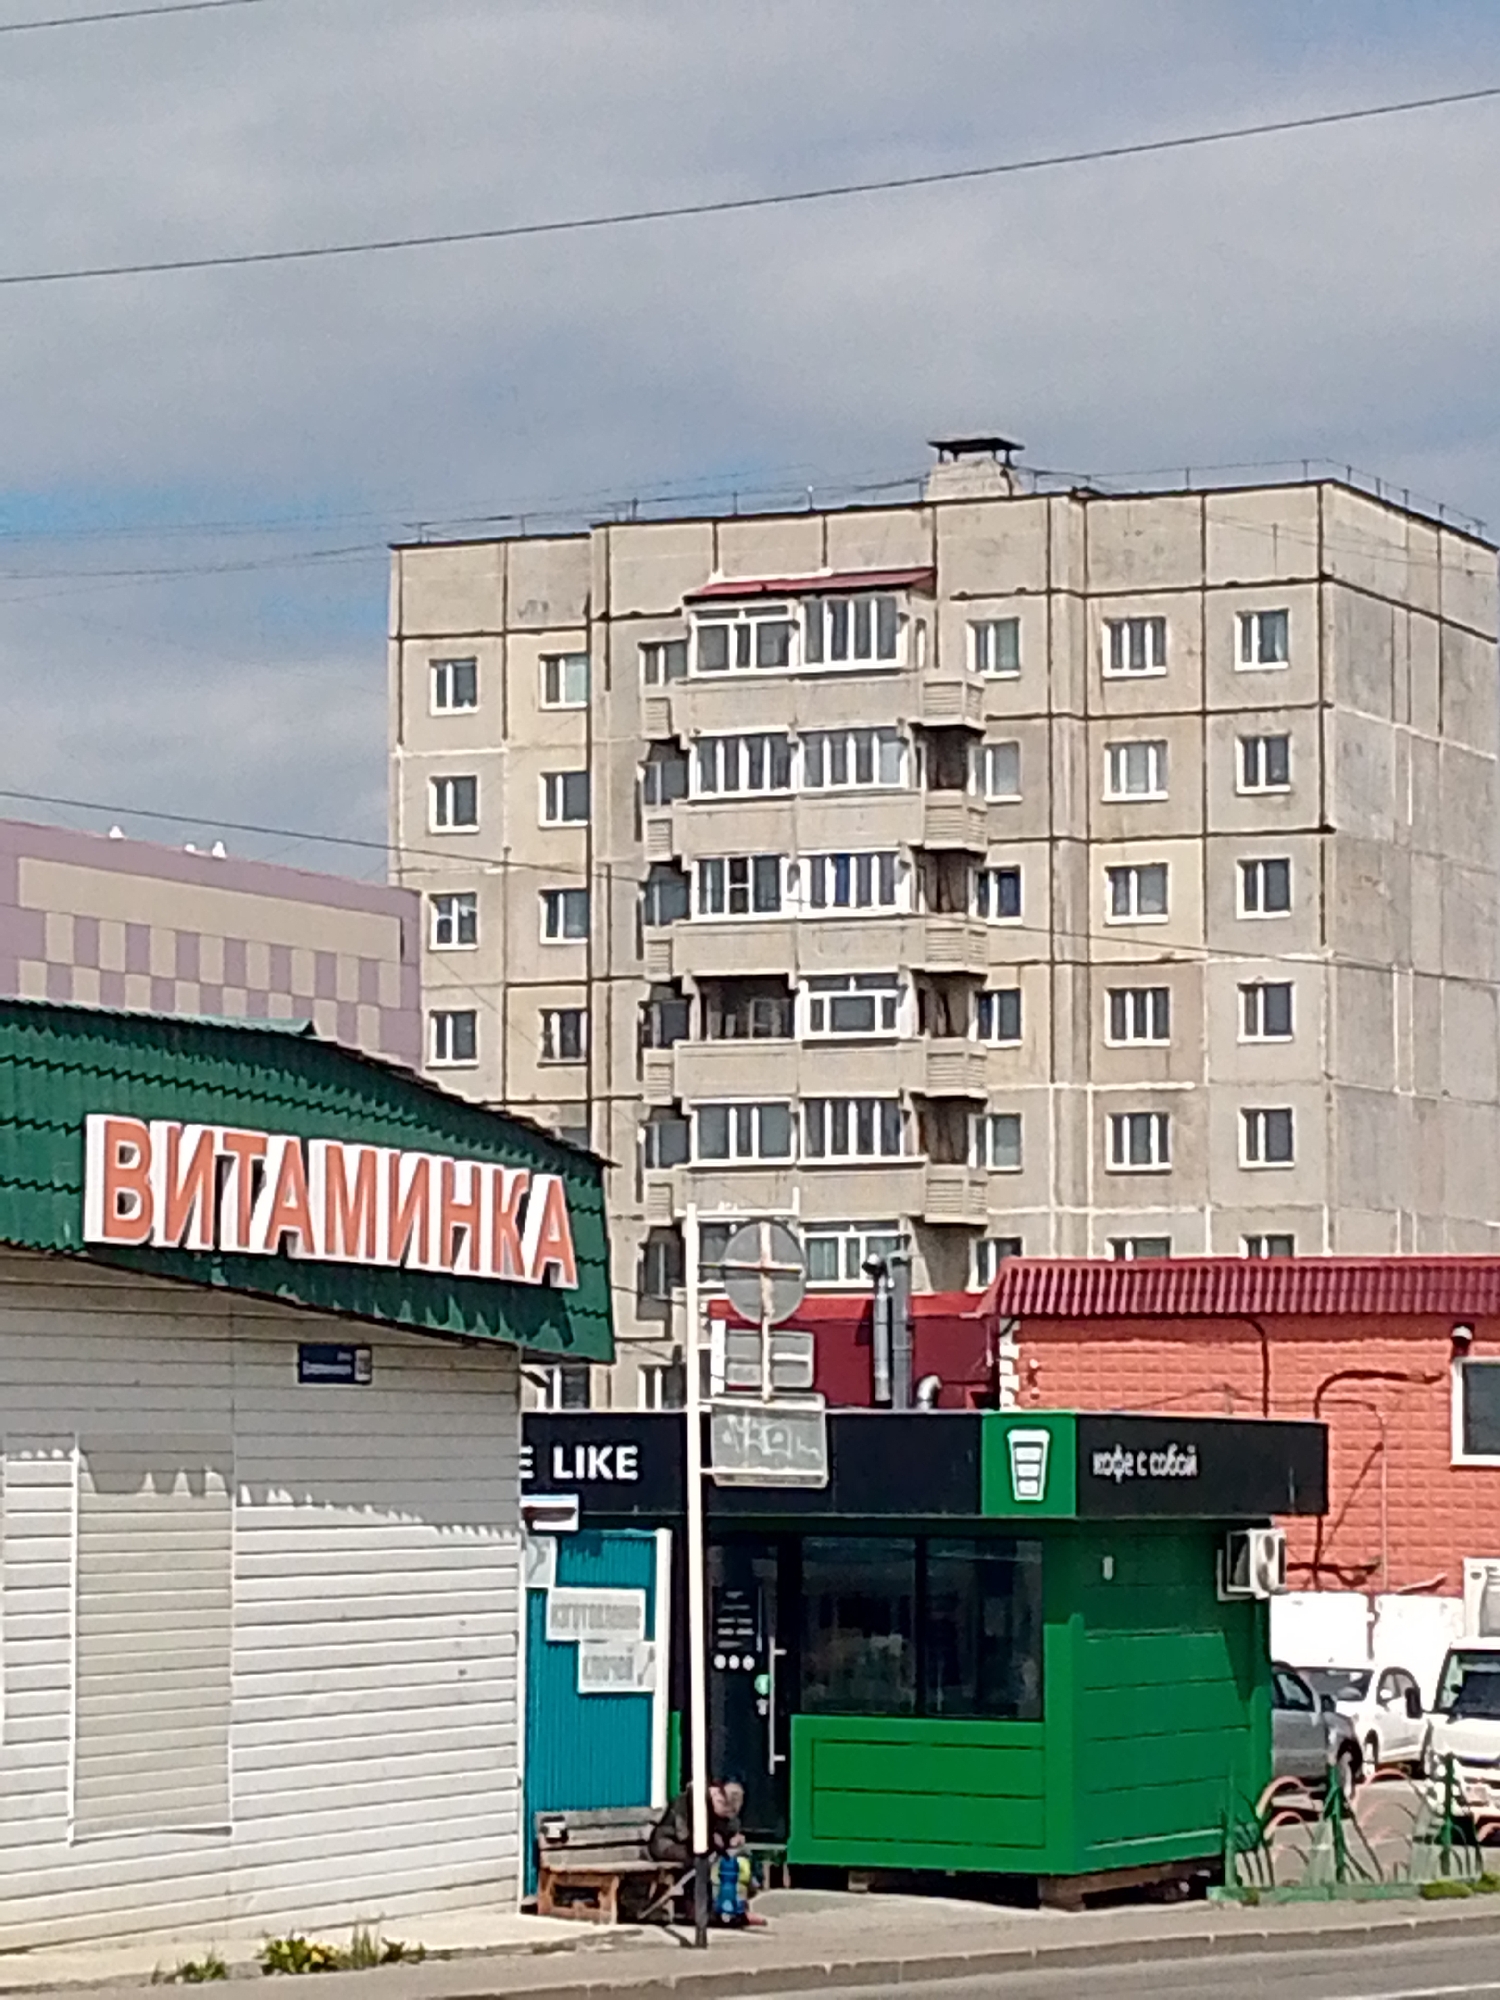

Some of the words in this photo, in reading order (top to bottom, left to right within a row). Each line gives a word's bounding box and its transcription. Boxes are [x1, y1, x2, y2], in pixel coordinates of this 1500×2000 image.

[85, 1114, 578, 1289] ВИТАМИНКА
[553, 1446, 639, 1480] LIKE
[1093, 1443, 1134, 1483] кофе
[1137, 1451, 1147, 1476] с
[1149, 1443, 1198, 1476] собой
